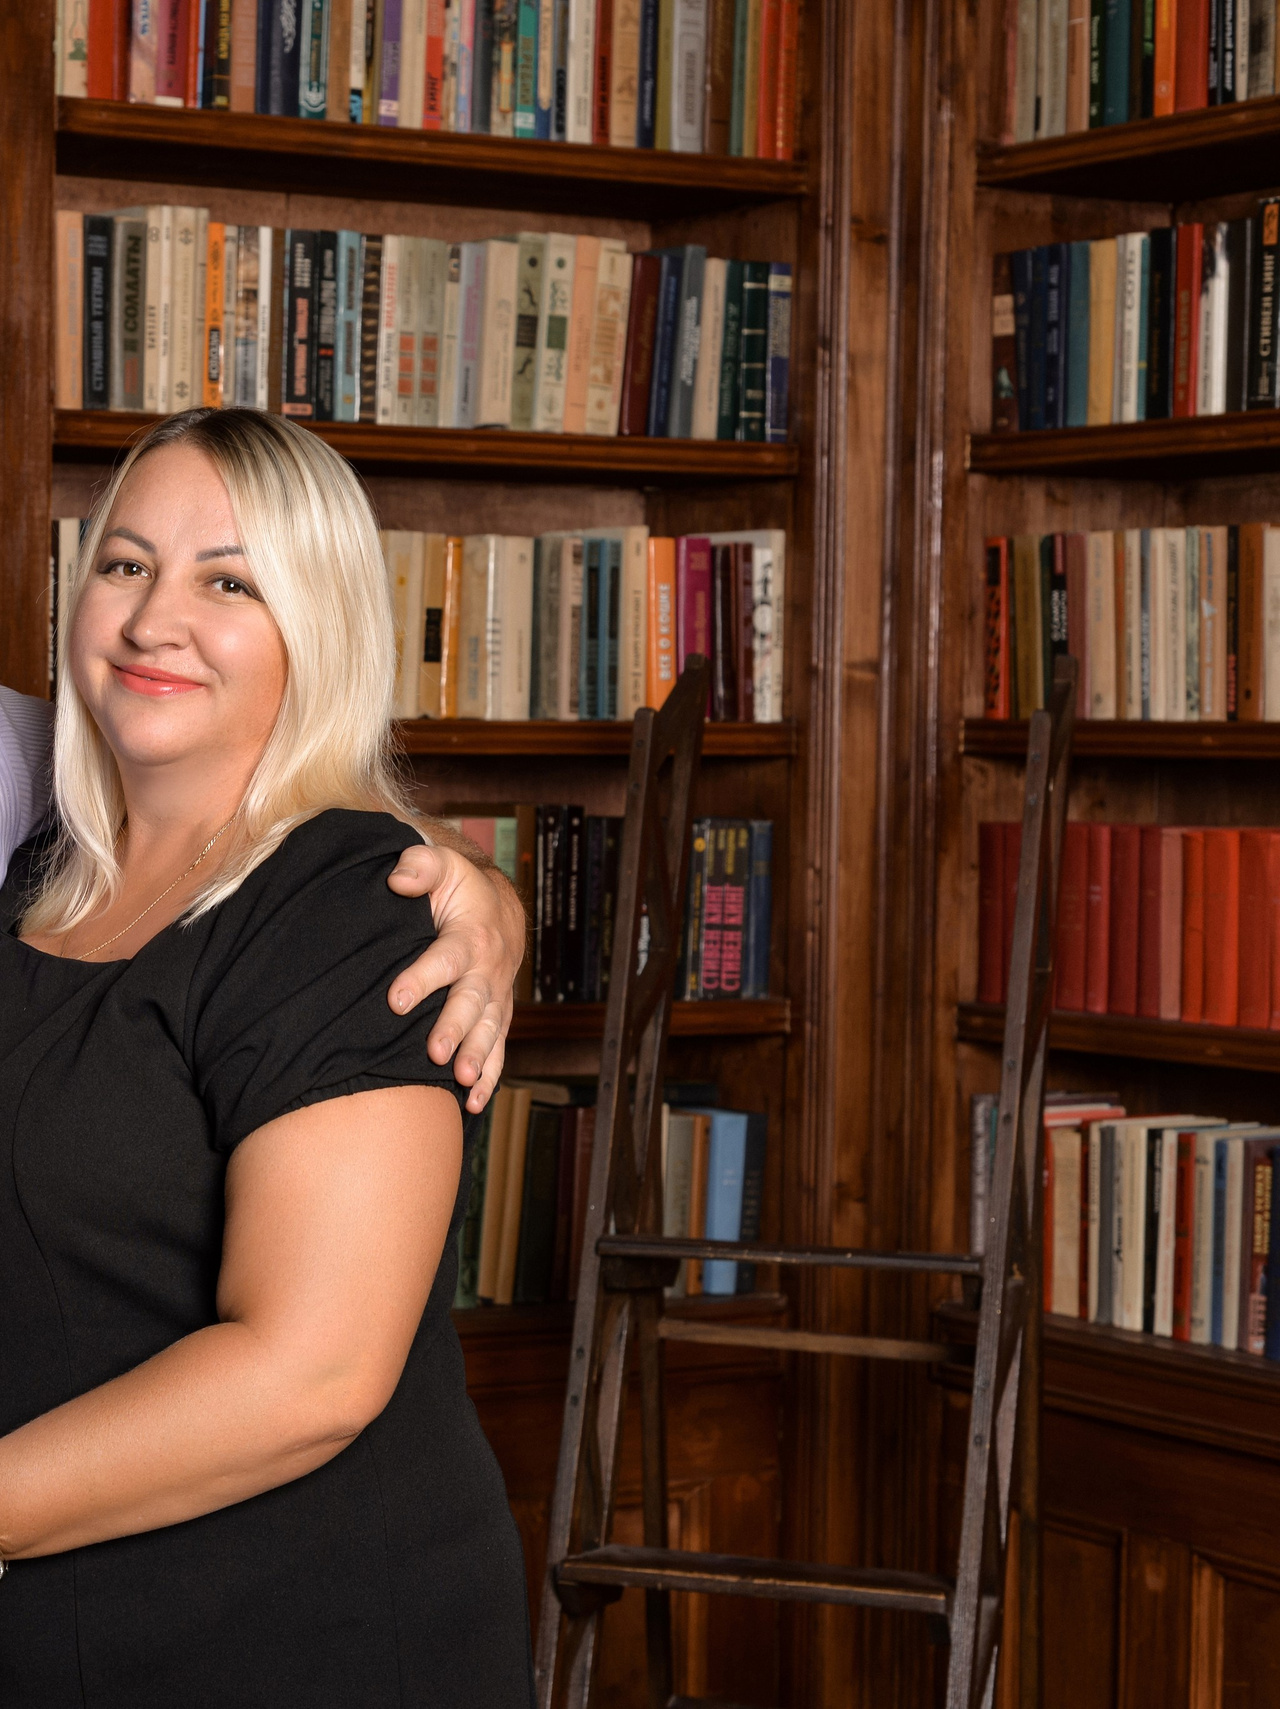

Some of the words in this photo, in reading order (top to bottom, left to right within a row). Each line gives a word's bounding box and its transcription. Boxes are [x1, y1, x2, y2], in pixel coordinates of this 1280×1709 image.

[124, 234, 141, 333] СОЛДАТЫ
[1261, 252, 1275, 293] КИНГ
[1258, 296, 1273, 357] СТИВЕН
[656, 582, 671, 635] КОШКЕ
[658, 637, 671, 650] О
[658, 653, 672, 681] ВСЕ
[704, 882, 727, 925] КИНГ
[722, 884, 745, 925] КИНГ
[701, 929, 724, 991] СТИВЕН
[720, 929, 743, 992] СТИВЕН
